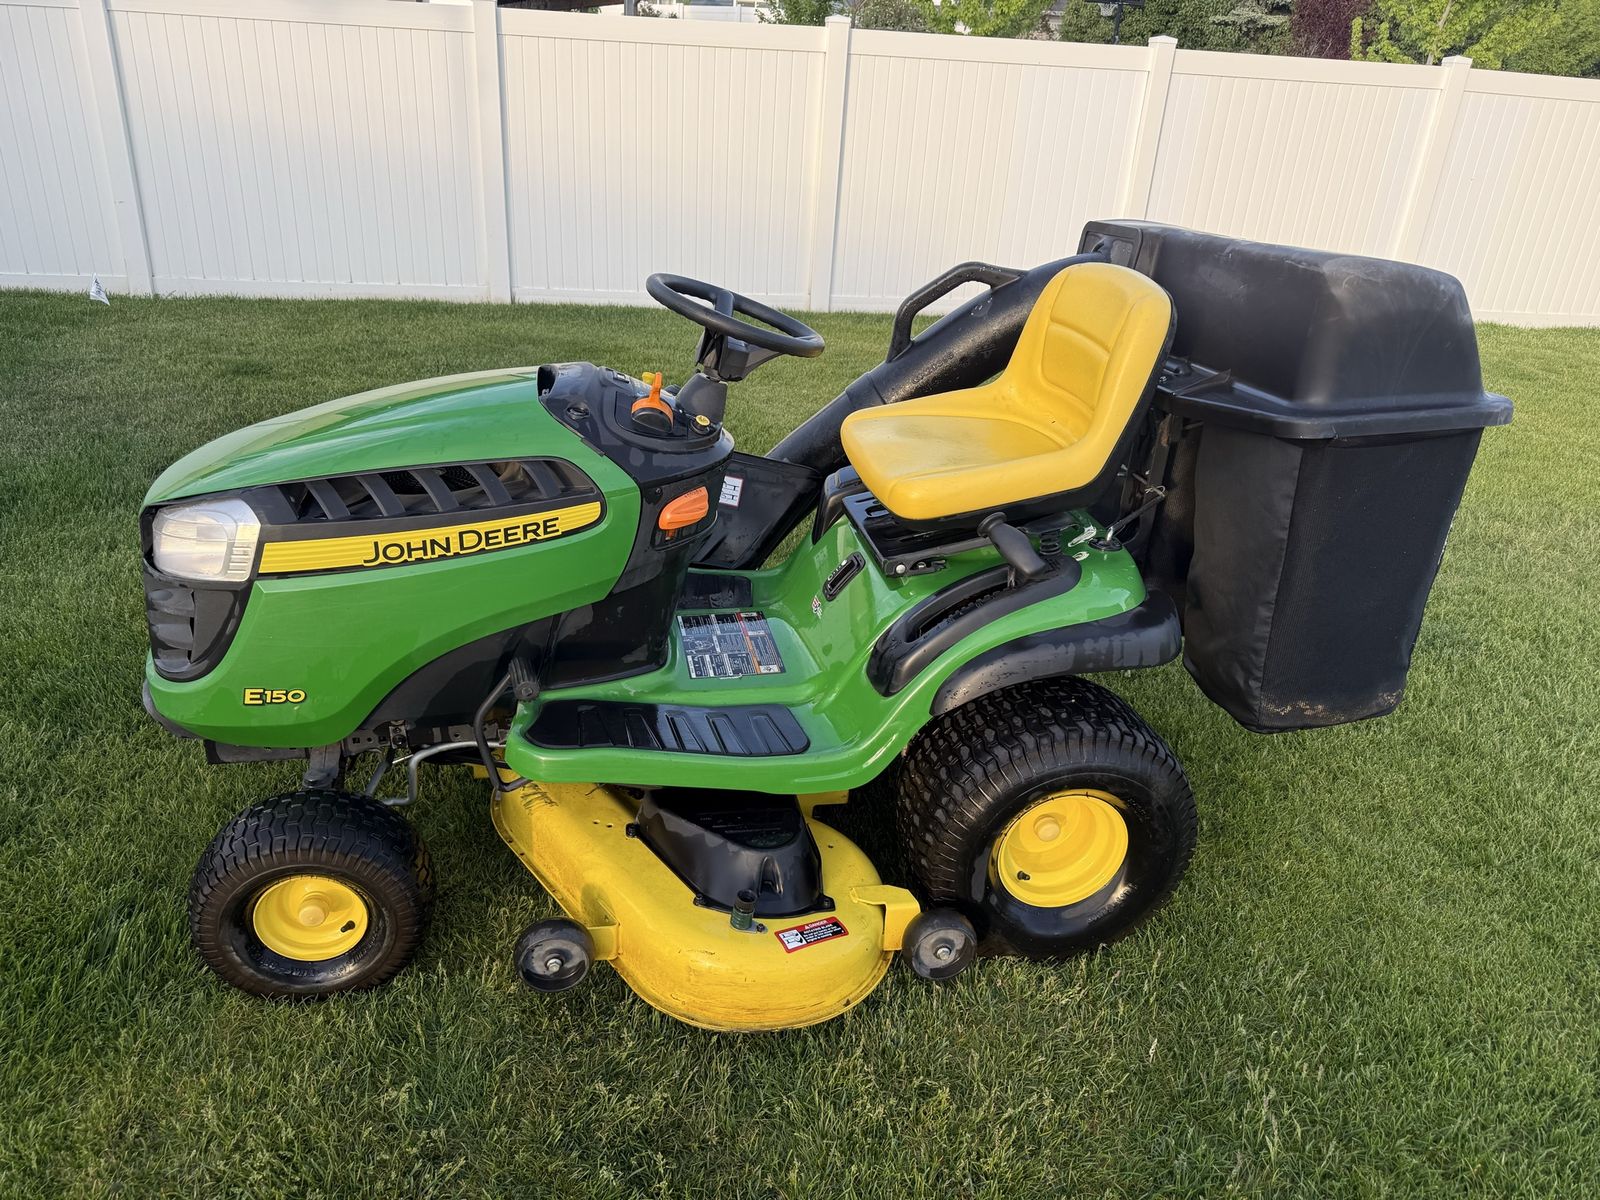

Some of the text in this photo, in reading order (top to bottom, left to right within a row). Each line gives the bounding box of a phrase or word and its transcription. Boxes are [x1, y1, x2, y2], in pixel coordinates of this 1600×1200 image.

[363, 516, 560, 564] JOHN DEERE
[243, 688, 307, 706] E150
